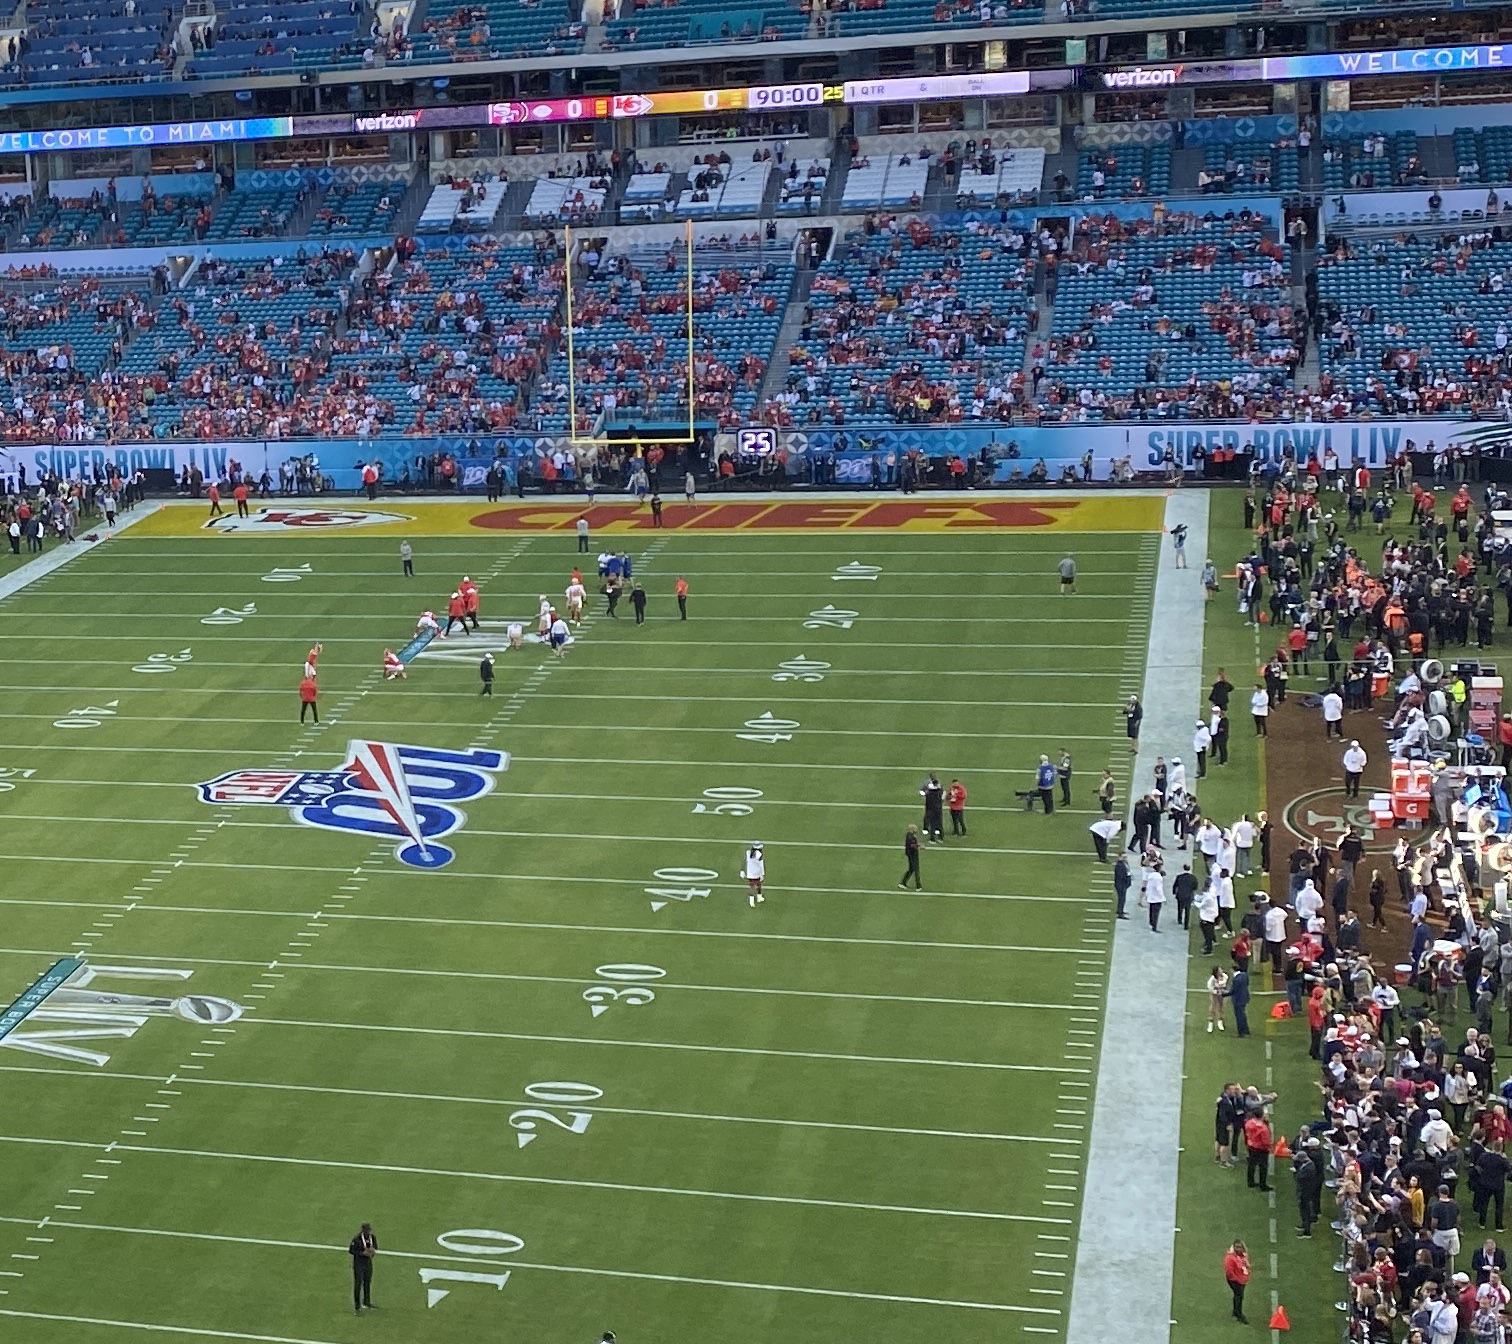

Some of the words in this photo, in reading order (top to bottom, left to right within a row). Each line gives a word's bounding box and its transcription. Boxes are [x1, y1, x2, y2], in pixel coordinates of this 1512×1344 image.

[1340, 46, 1504, 72] WELCOME
[1104, 67, 1175, 88] verizon
[704, 91, 719, 110] 0
[756, 86, 821, 107] 90:00
[823, 86, 845, 101] 25
[860, 85, 885, 97] QTR
[568, 99, 582, 119] 0
[124, 126, 155, 144] TO
[170, 120, 246, 141] MIAMI
[355, 112, 417, 132] verizon
[743, 433, 770, 452] 25
[1147, 430, 1241, 467] SUPER
[1351, 427, 1402, 465] LIV
[34, 448, 108, 482] SUPER
[469, 502, 1080, 530] CHIEFS
[1406, 803, 1418, 814] G
[23, 975, 64, 1008] SUPER
[509, 1080, 604, 1135] 20
[418, 1228, 525, 1292] 10
